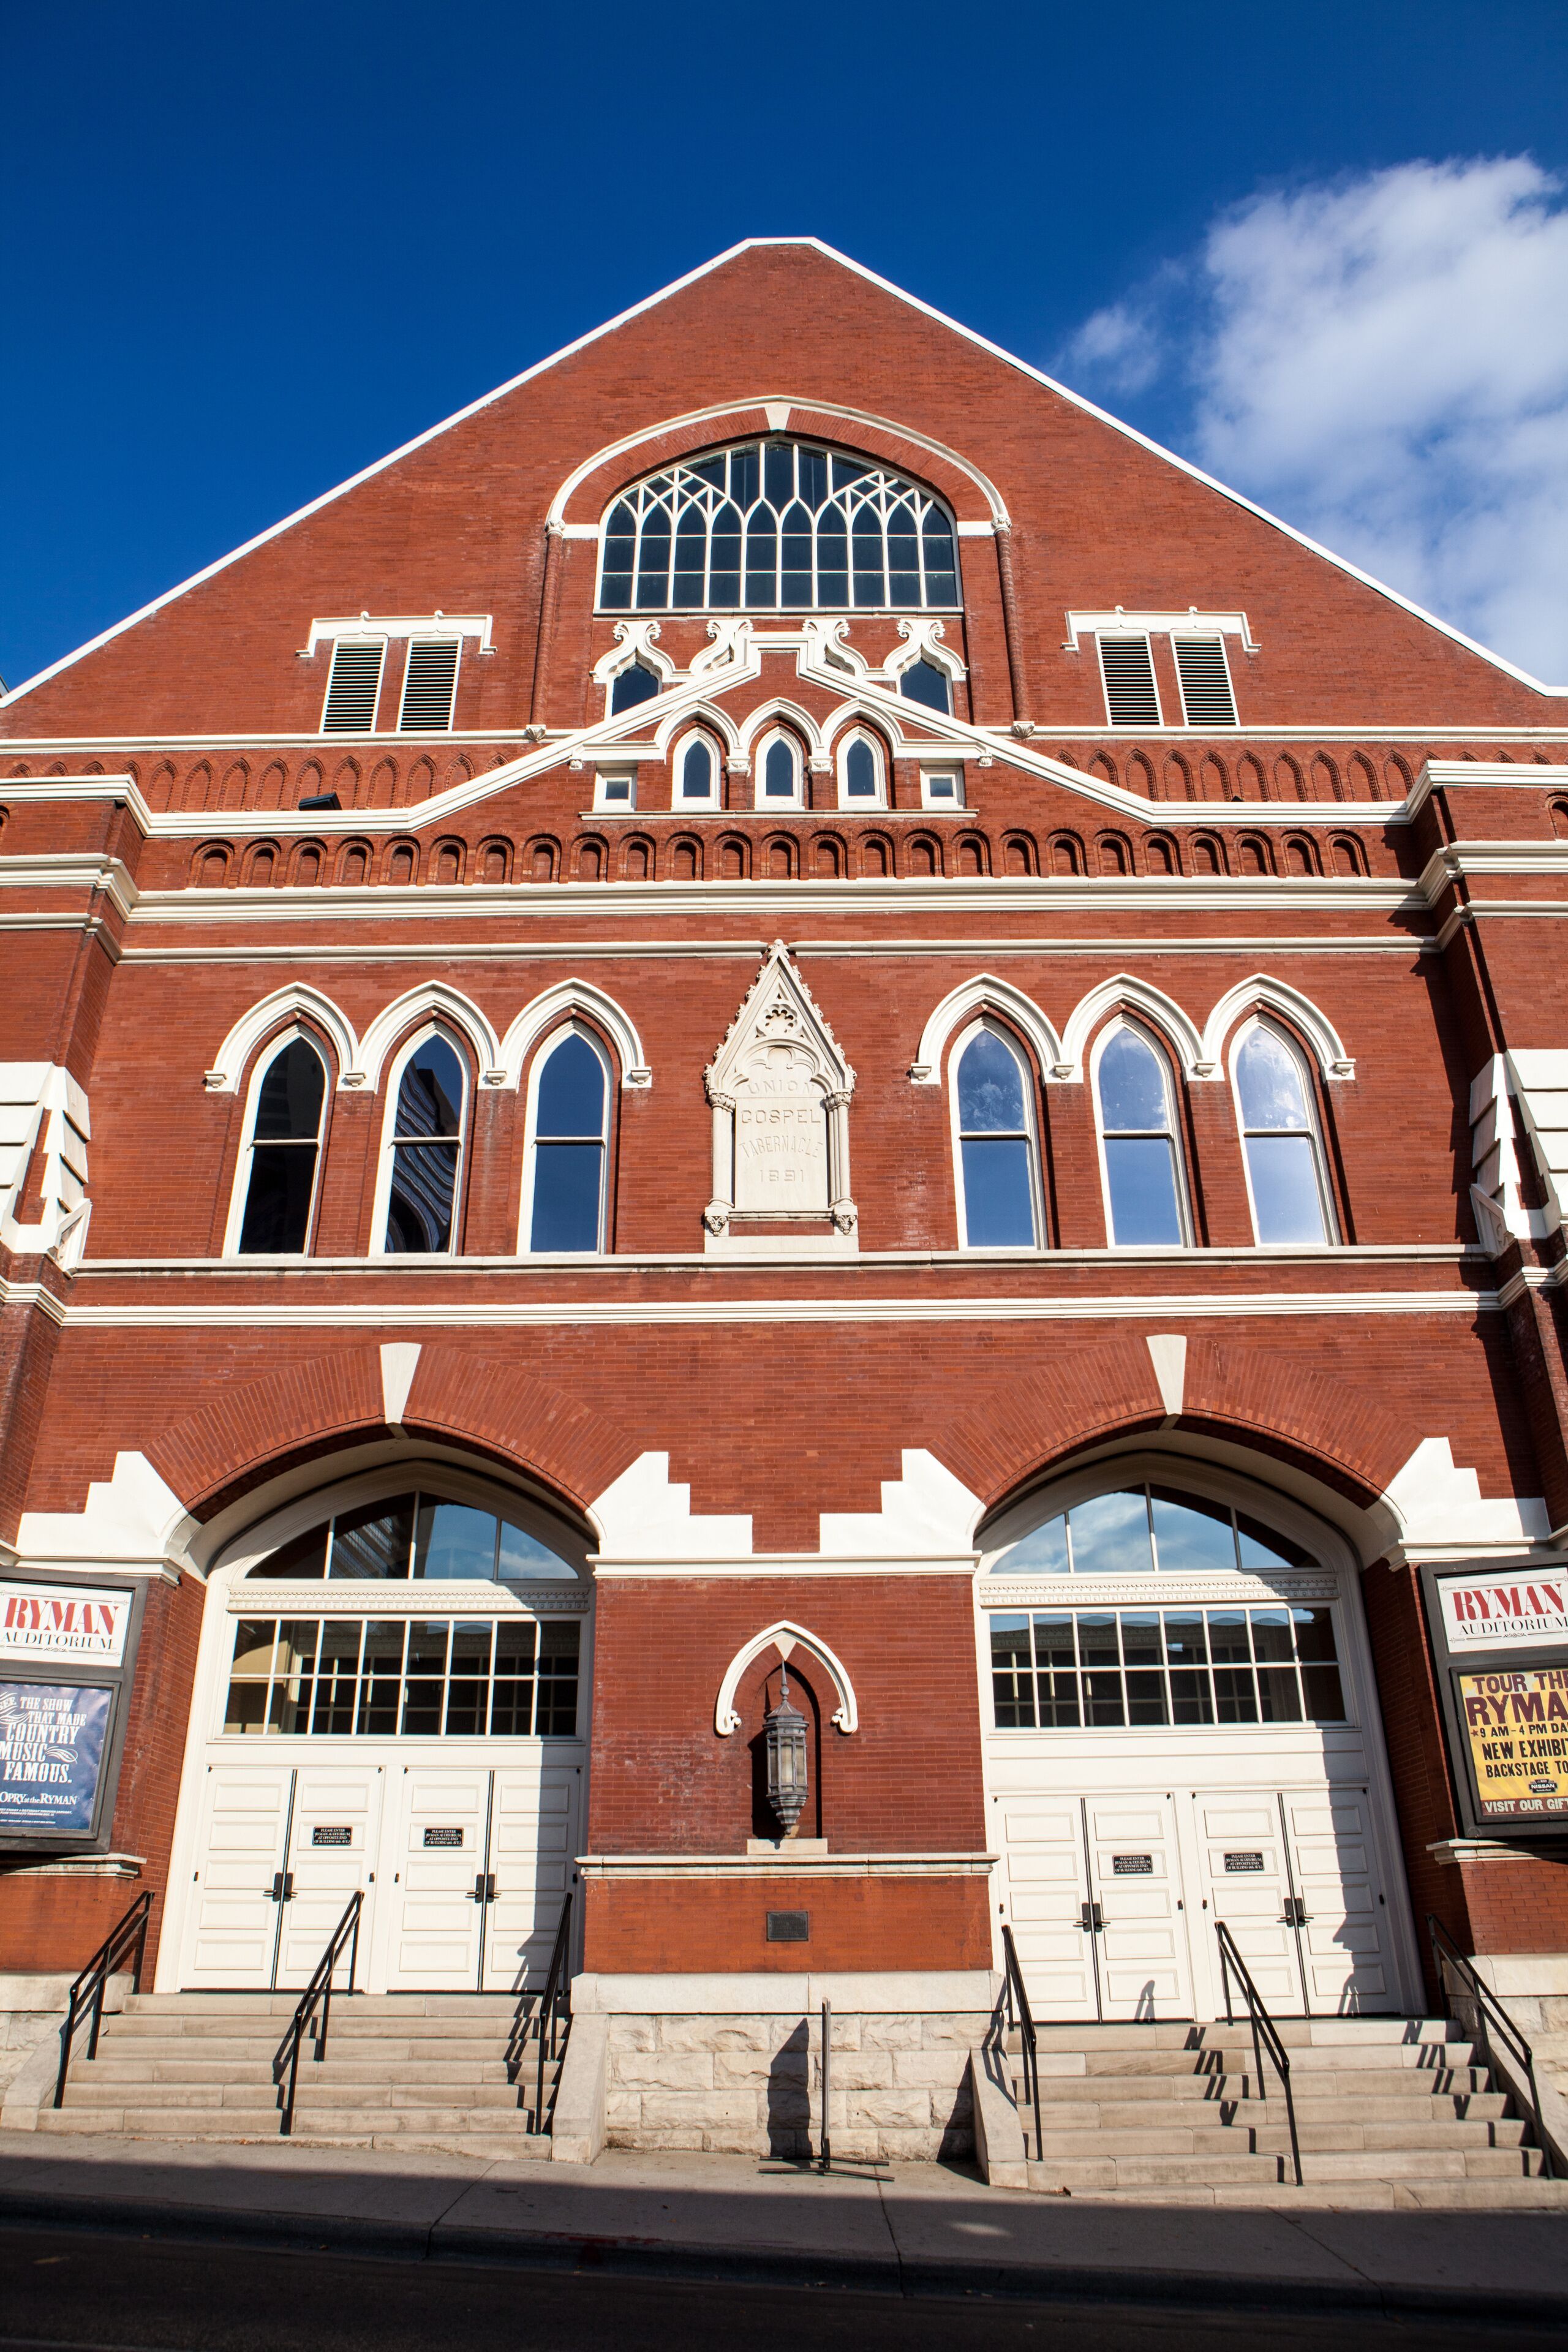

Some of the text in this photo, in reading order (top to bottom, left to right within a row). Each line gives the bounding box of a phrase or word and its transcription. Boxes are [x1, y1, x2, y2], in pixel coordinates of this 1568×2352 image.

[747, 1079, 815, 1095] UNION
[741, 1109, 821, 1124] GOSPEL
[739, 1136, 823, 1158] TABERNACLE
[760, 1169, 804, 1182] 1891
[1452, 1583, 1565, 1621] RYMAN
[4, 1597, 120, 1635] RYMAN
[1459, 1616, 1568, 1635] AUDITORIUM
[1, 1632, 113, 1649] AUDITORIUM
[1471, 1674, 1528, 1695] TOUR
[20, 1697, 41, 1709] THE
[42, 1698, 74, 1712] SHOW
[1465, 1691, 1568, 1726] RYMA
[28, 1711, 87, 1726] THAT MADE
[6, 1723, 80, 1744] COUNTRY
[1480, 1728, 1486, 1738] 9
[1491, 1725, 1509, 1737] AM
[1519, 1725, 1525, 1735] 4
[1528, 1724, 1547, 1735] PM
[0, 1741, 48, 1762] MUSIC
[1482, 1741, 1513, 1760] NEW
[2, 1761, 72, 1784] FAMOUS.
[1485, 1762, 1550, 1778] BACKSTAGE
[0, 1792, 28, 1804] OPRY
[40, 1793, 78, 1805] RYMAN
[1484, 1800, 1515, 1813] VISIT
[1520, 1799, 1544, 1811] OUR
